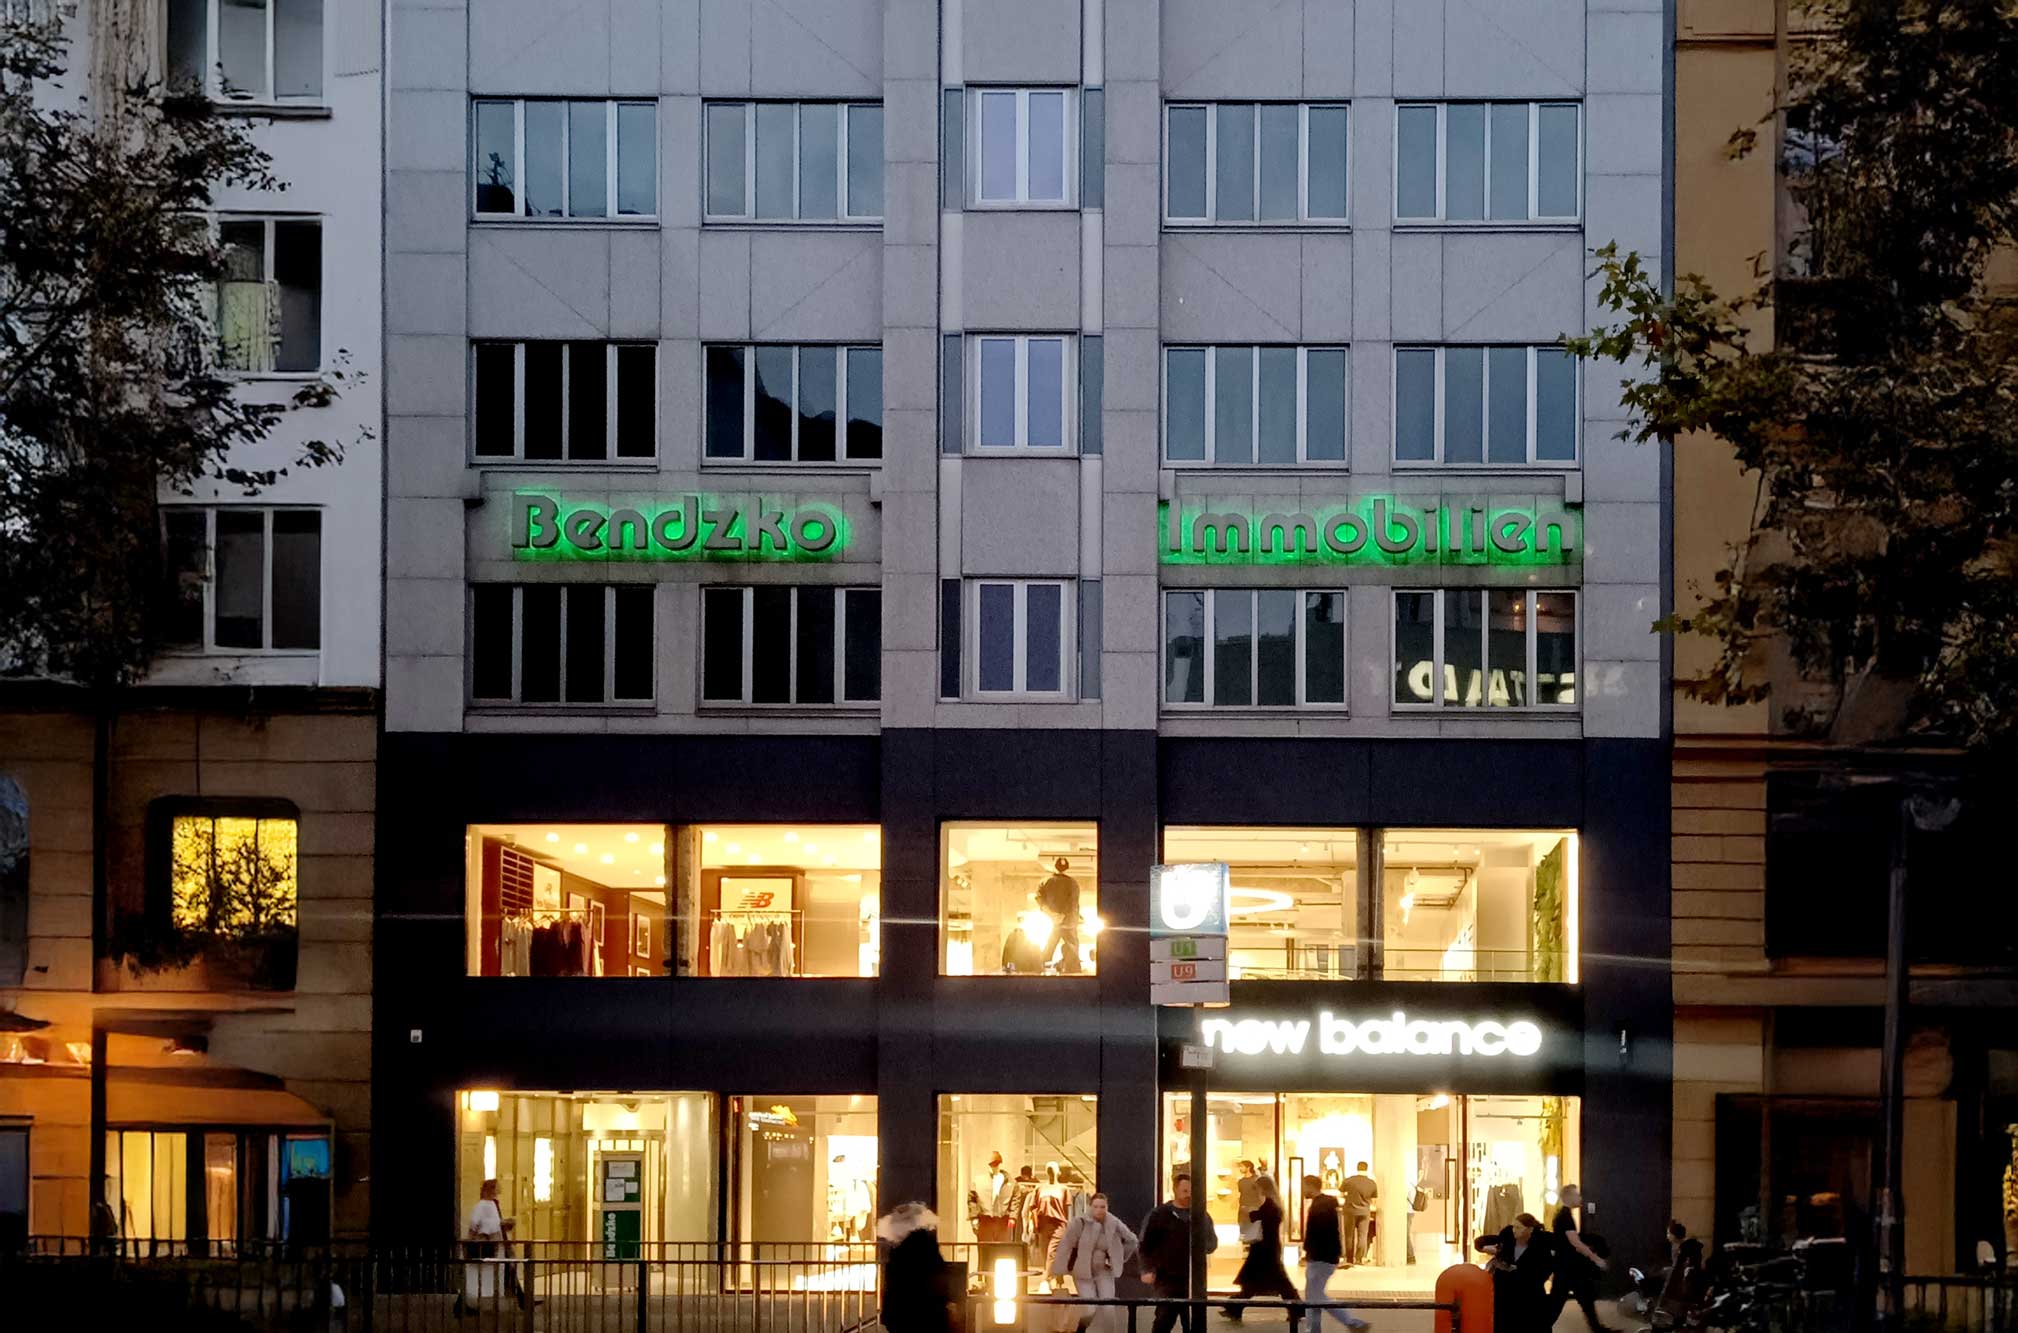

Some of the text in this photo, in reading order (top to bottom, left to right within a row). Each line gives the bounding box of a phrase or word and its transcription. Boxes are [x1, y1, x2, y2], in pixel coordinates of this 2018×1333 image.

[512, 491, 836, 552] Bendzko
[1168, 498, 1574, 554] Immobilien
[1173, 965, 1194, 978] U9
[1201, 1011, 1542, 1056] new balance
